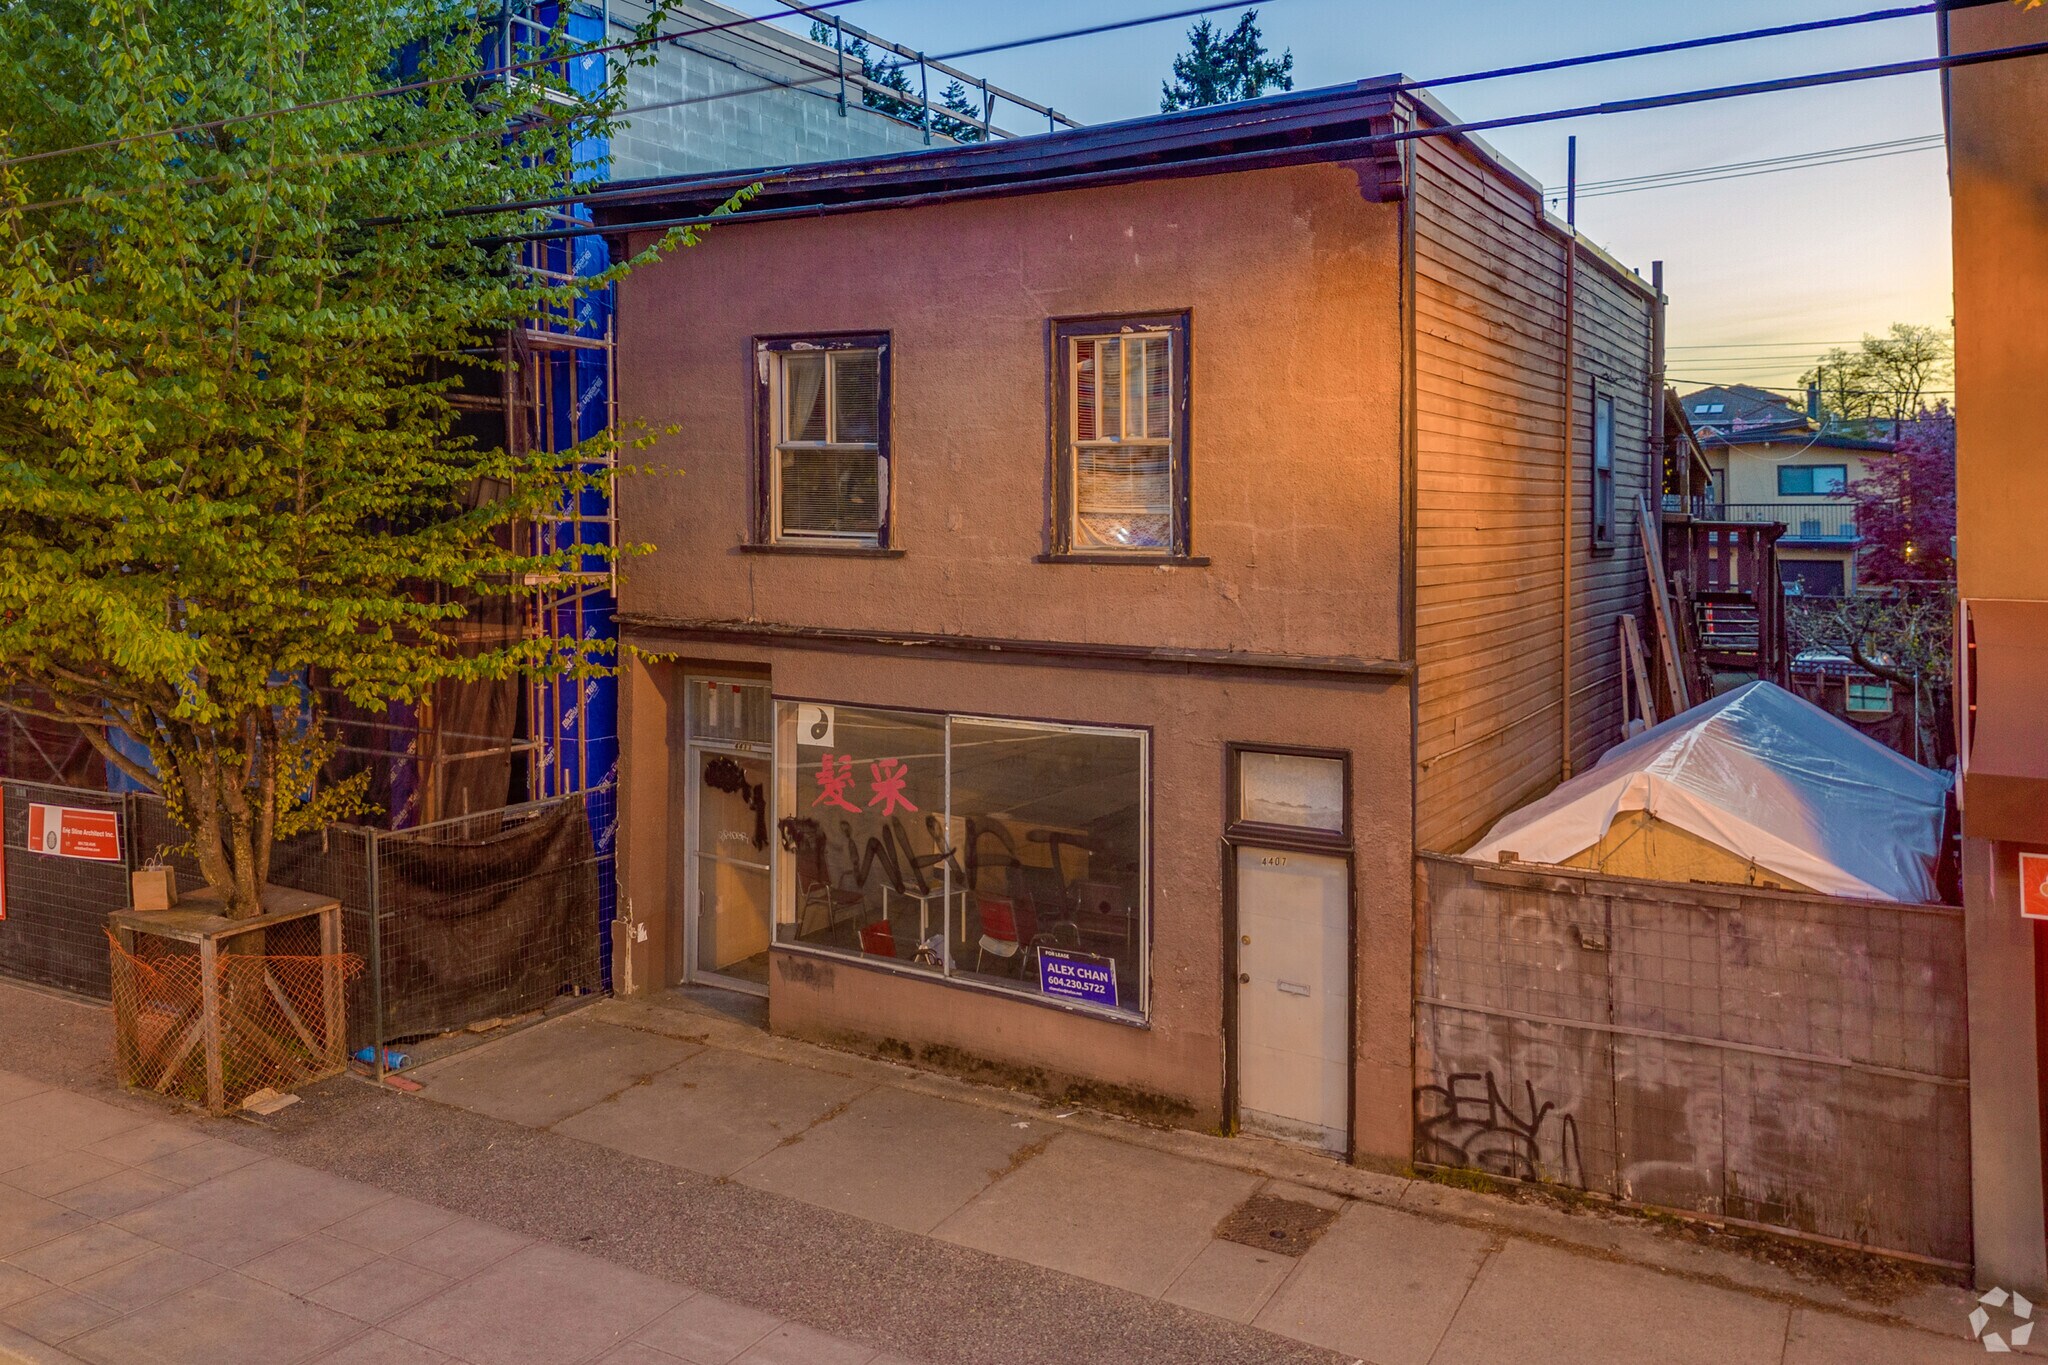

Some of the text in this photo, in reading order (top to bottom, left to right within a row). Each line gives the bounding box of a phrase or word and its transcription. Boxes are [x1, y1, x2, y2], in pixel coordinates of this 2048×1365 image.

[83, 829, 104, 837] Architect
[1262, 857, 1287, 866] 4407
[1047, 962, 1108, 982] ALEX CHAN
[1048, 976, 1105, 994] 604.230.5722
